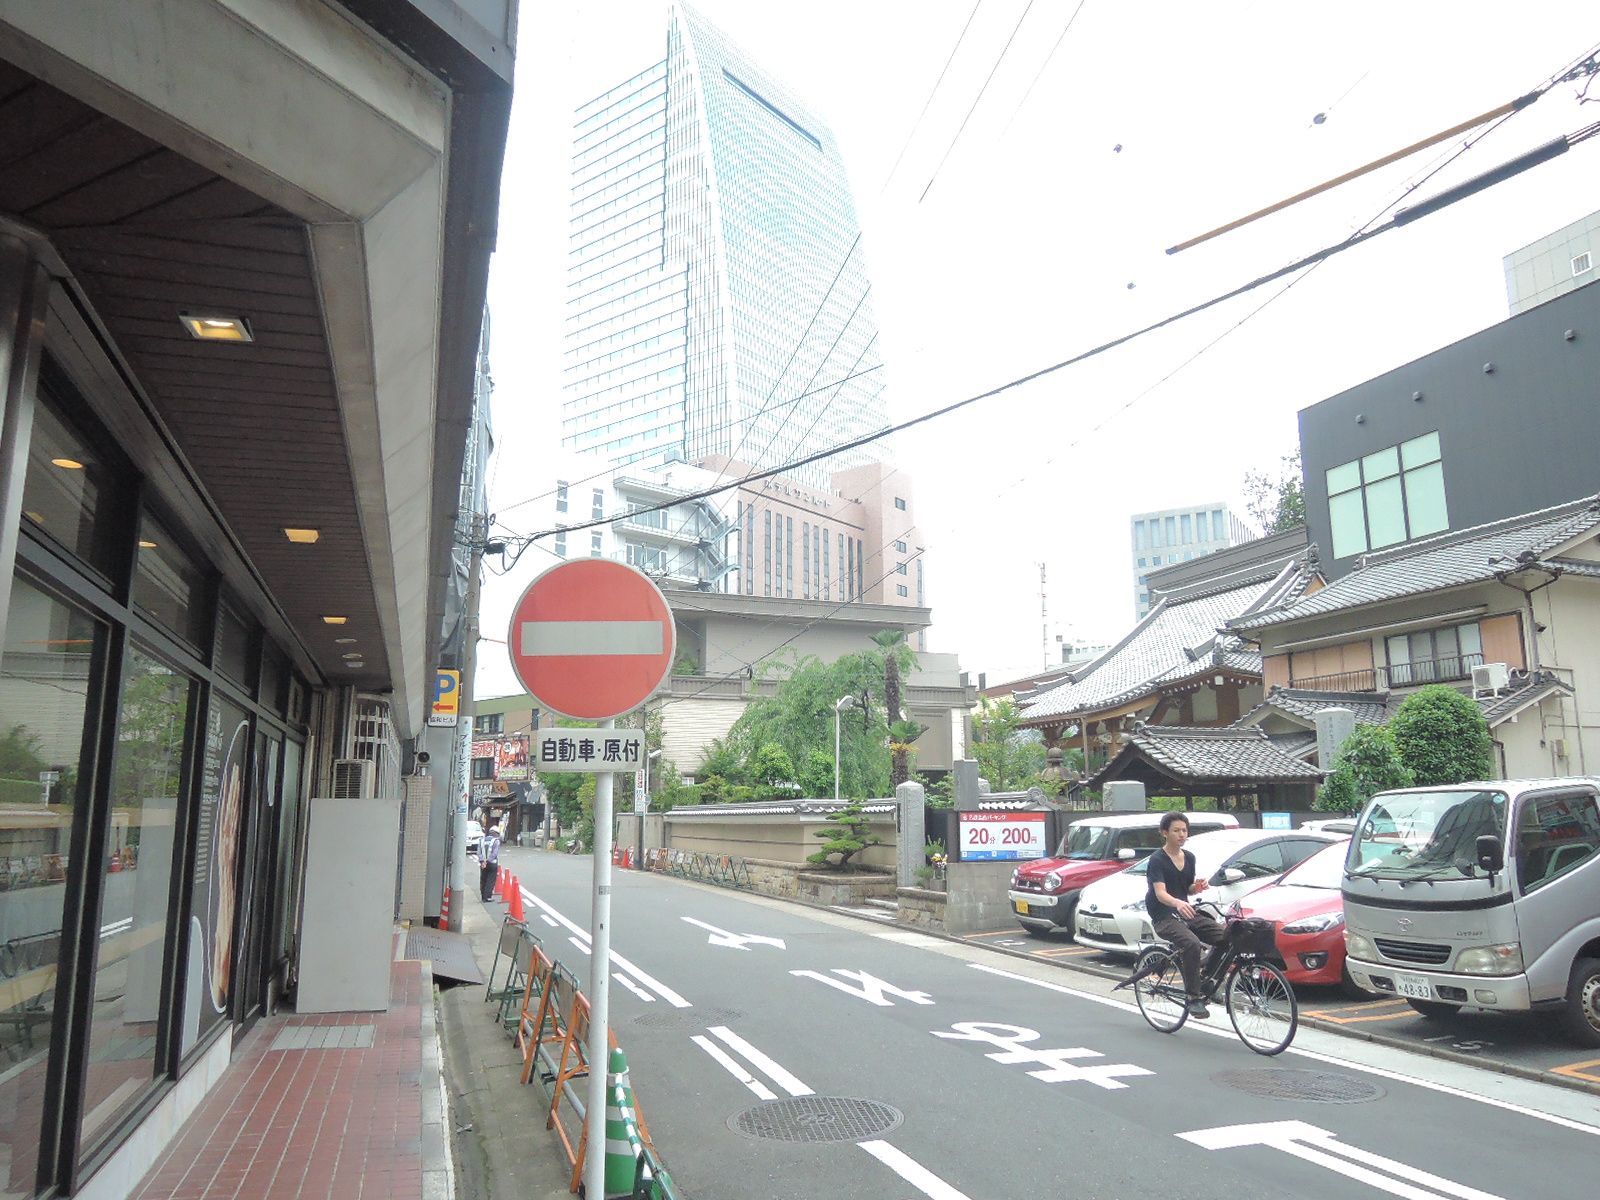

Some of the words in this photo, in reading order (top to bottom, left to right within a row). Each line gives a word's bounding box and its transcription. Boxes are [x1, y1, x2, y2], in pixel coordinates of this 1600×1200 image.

[433, 674, 456, 702] P
[542, 737, 640, 762] 自動車・原付
[969, 828, 996, 844] 20分
[1002, 828, 1037, 844] 200円
